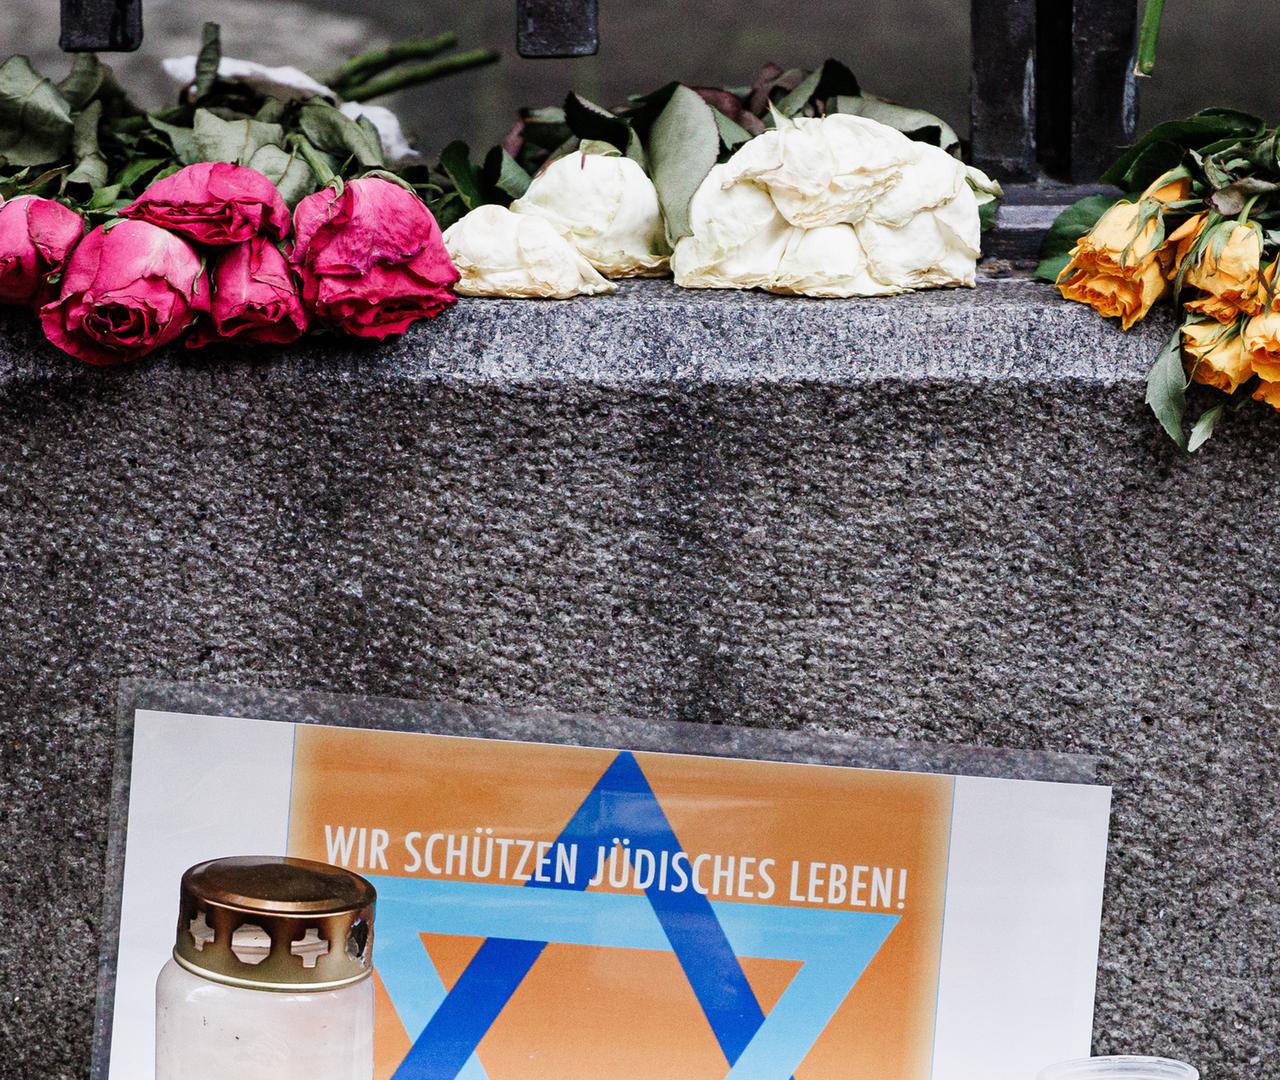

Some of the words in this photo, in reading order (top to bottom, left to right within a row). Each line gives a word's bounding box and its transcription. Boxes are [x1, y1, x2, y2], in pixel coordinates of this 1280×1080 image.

[324, 825, 389, 870] WIR
[404, 827, 577, 884] SCHÜTZEN
[589, 837, 776, 899] JÜDISCHES
[789, 860, 908, 910] LEBEN!
